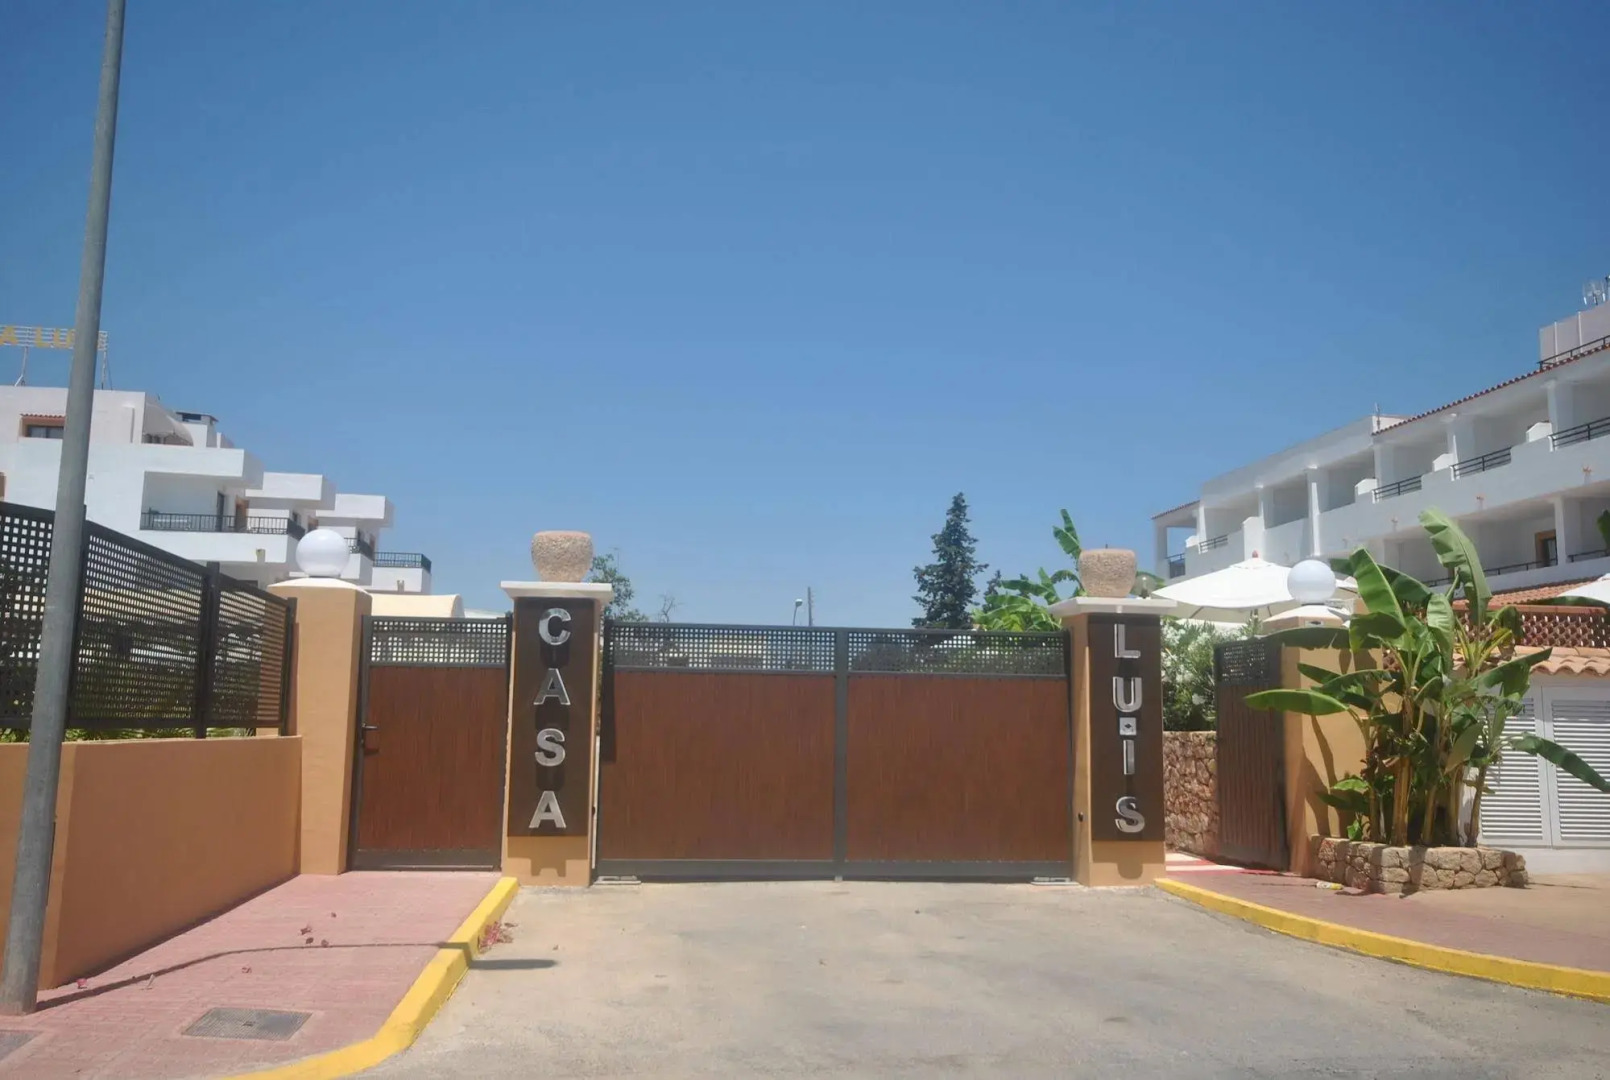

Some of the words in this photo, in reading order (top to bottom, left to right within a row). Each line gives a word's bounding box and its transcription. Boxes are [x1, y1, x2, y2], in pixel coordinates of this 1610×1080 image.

[35, 327, 76, 349] LU
[528, 607, 572, 829] CASA
[1112, 623, 1146, 833] LUIS
